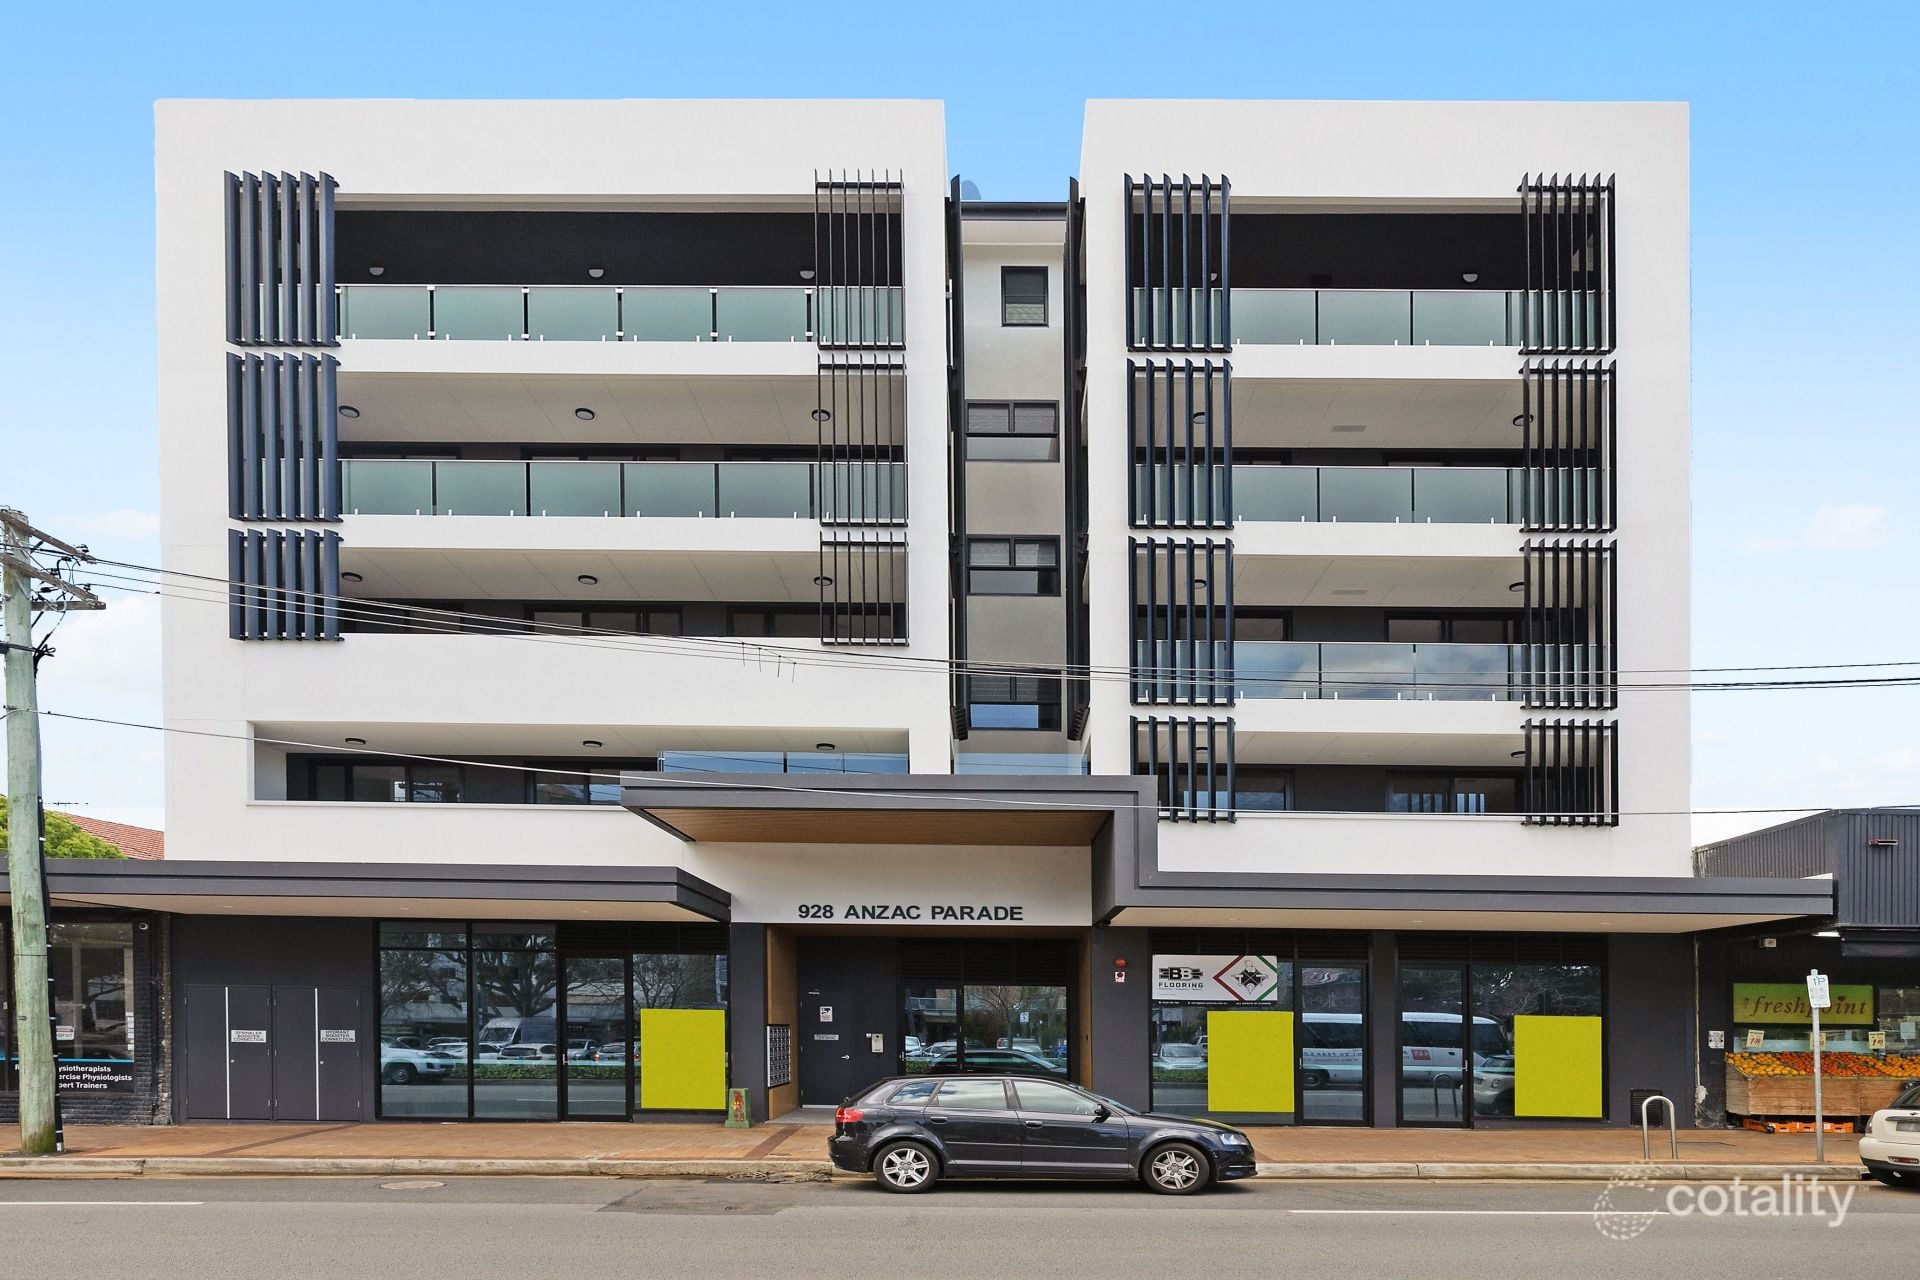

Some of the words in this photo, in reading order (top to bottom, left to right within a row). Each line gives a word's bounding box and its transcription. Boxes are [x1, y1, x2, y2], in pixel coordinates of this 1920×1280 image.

[798, 904, 834, 919] 928
[844, 905, 921, 920] ANZAC
[931, 905, 1024, 921] PARADE
[58, 1065, 112, 1073] ysiotherapists
[82, 1073, 133, 1082] Physiologists
